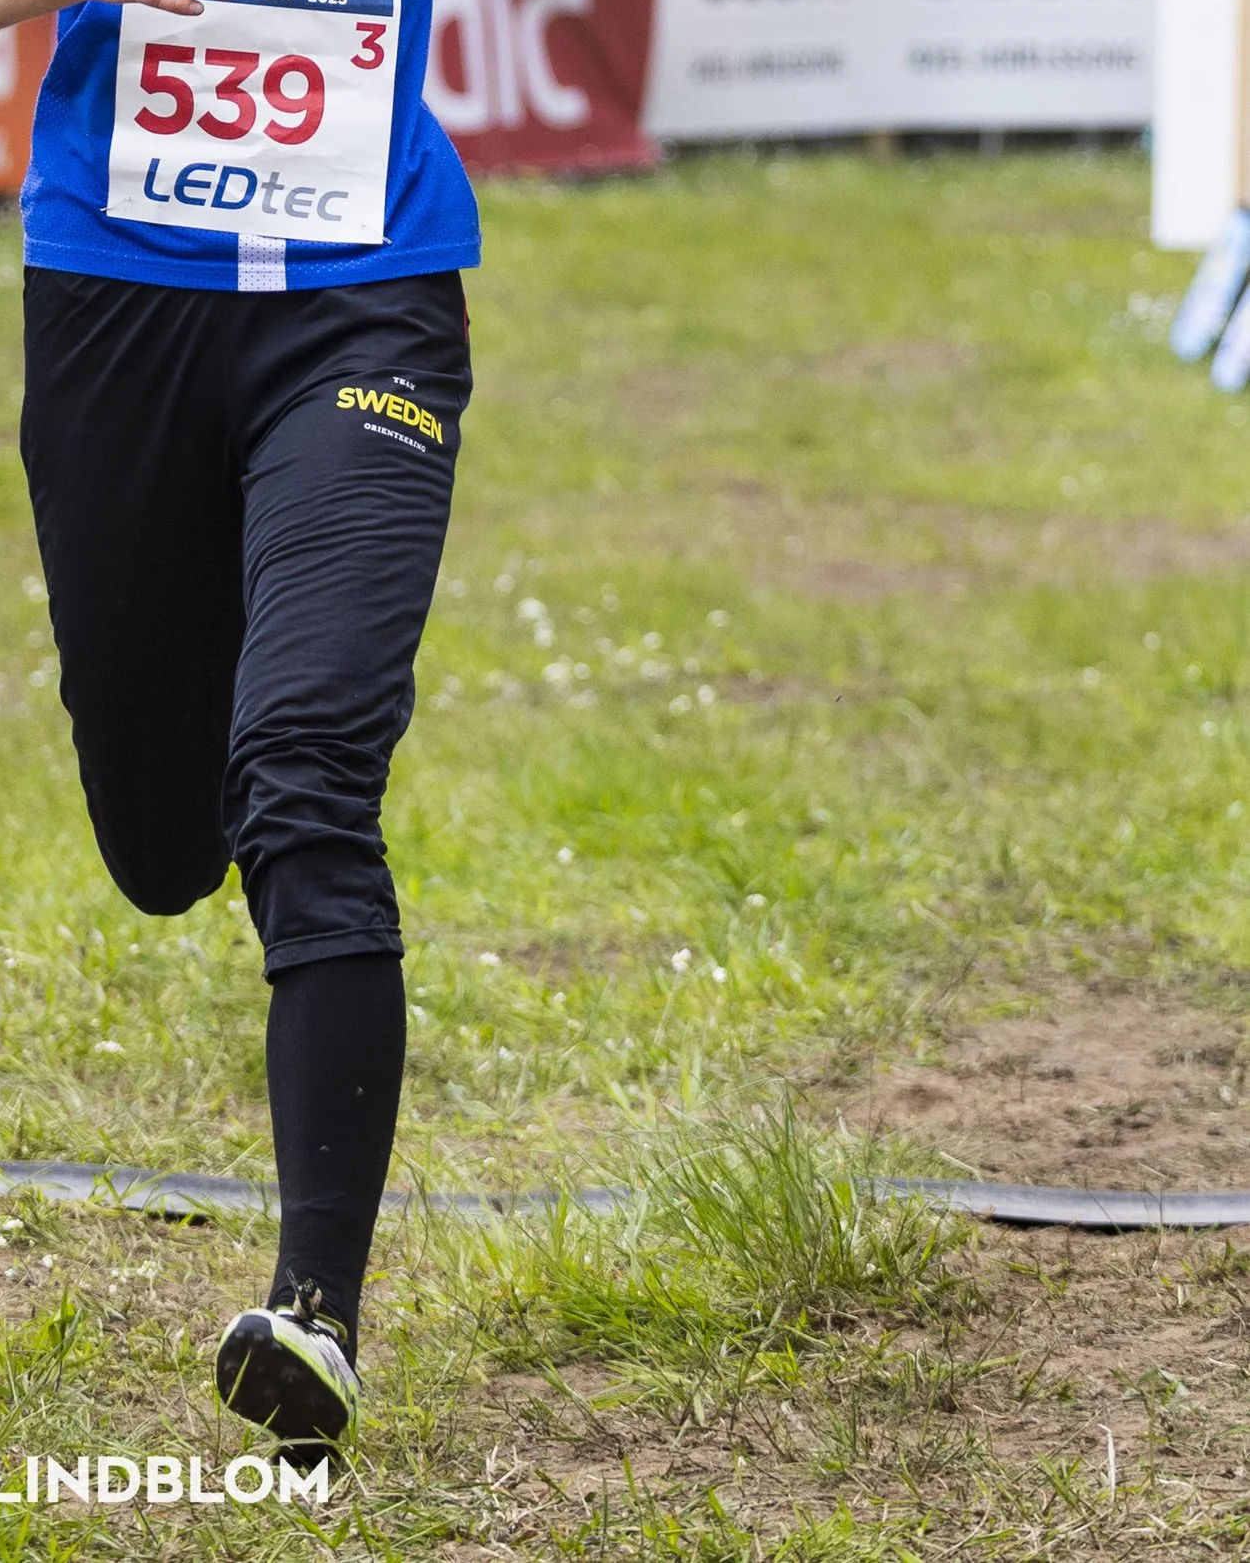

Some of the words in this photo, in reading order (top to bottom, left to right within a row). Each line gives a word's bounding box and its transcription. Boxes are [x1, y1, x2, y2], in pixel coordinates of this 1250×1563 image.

[350, 22, 387, 69] 3
[134, 42, 326, 145] 539
[336, 387, 443, 444] SWEDEN
